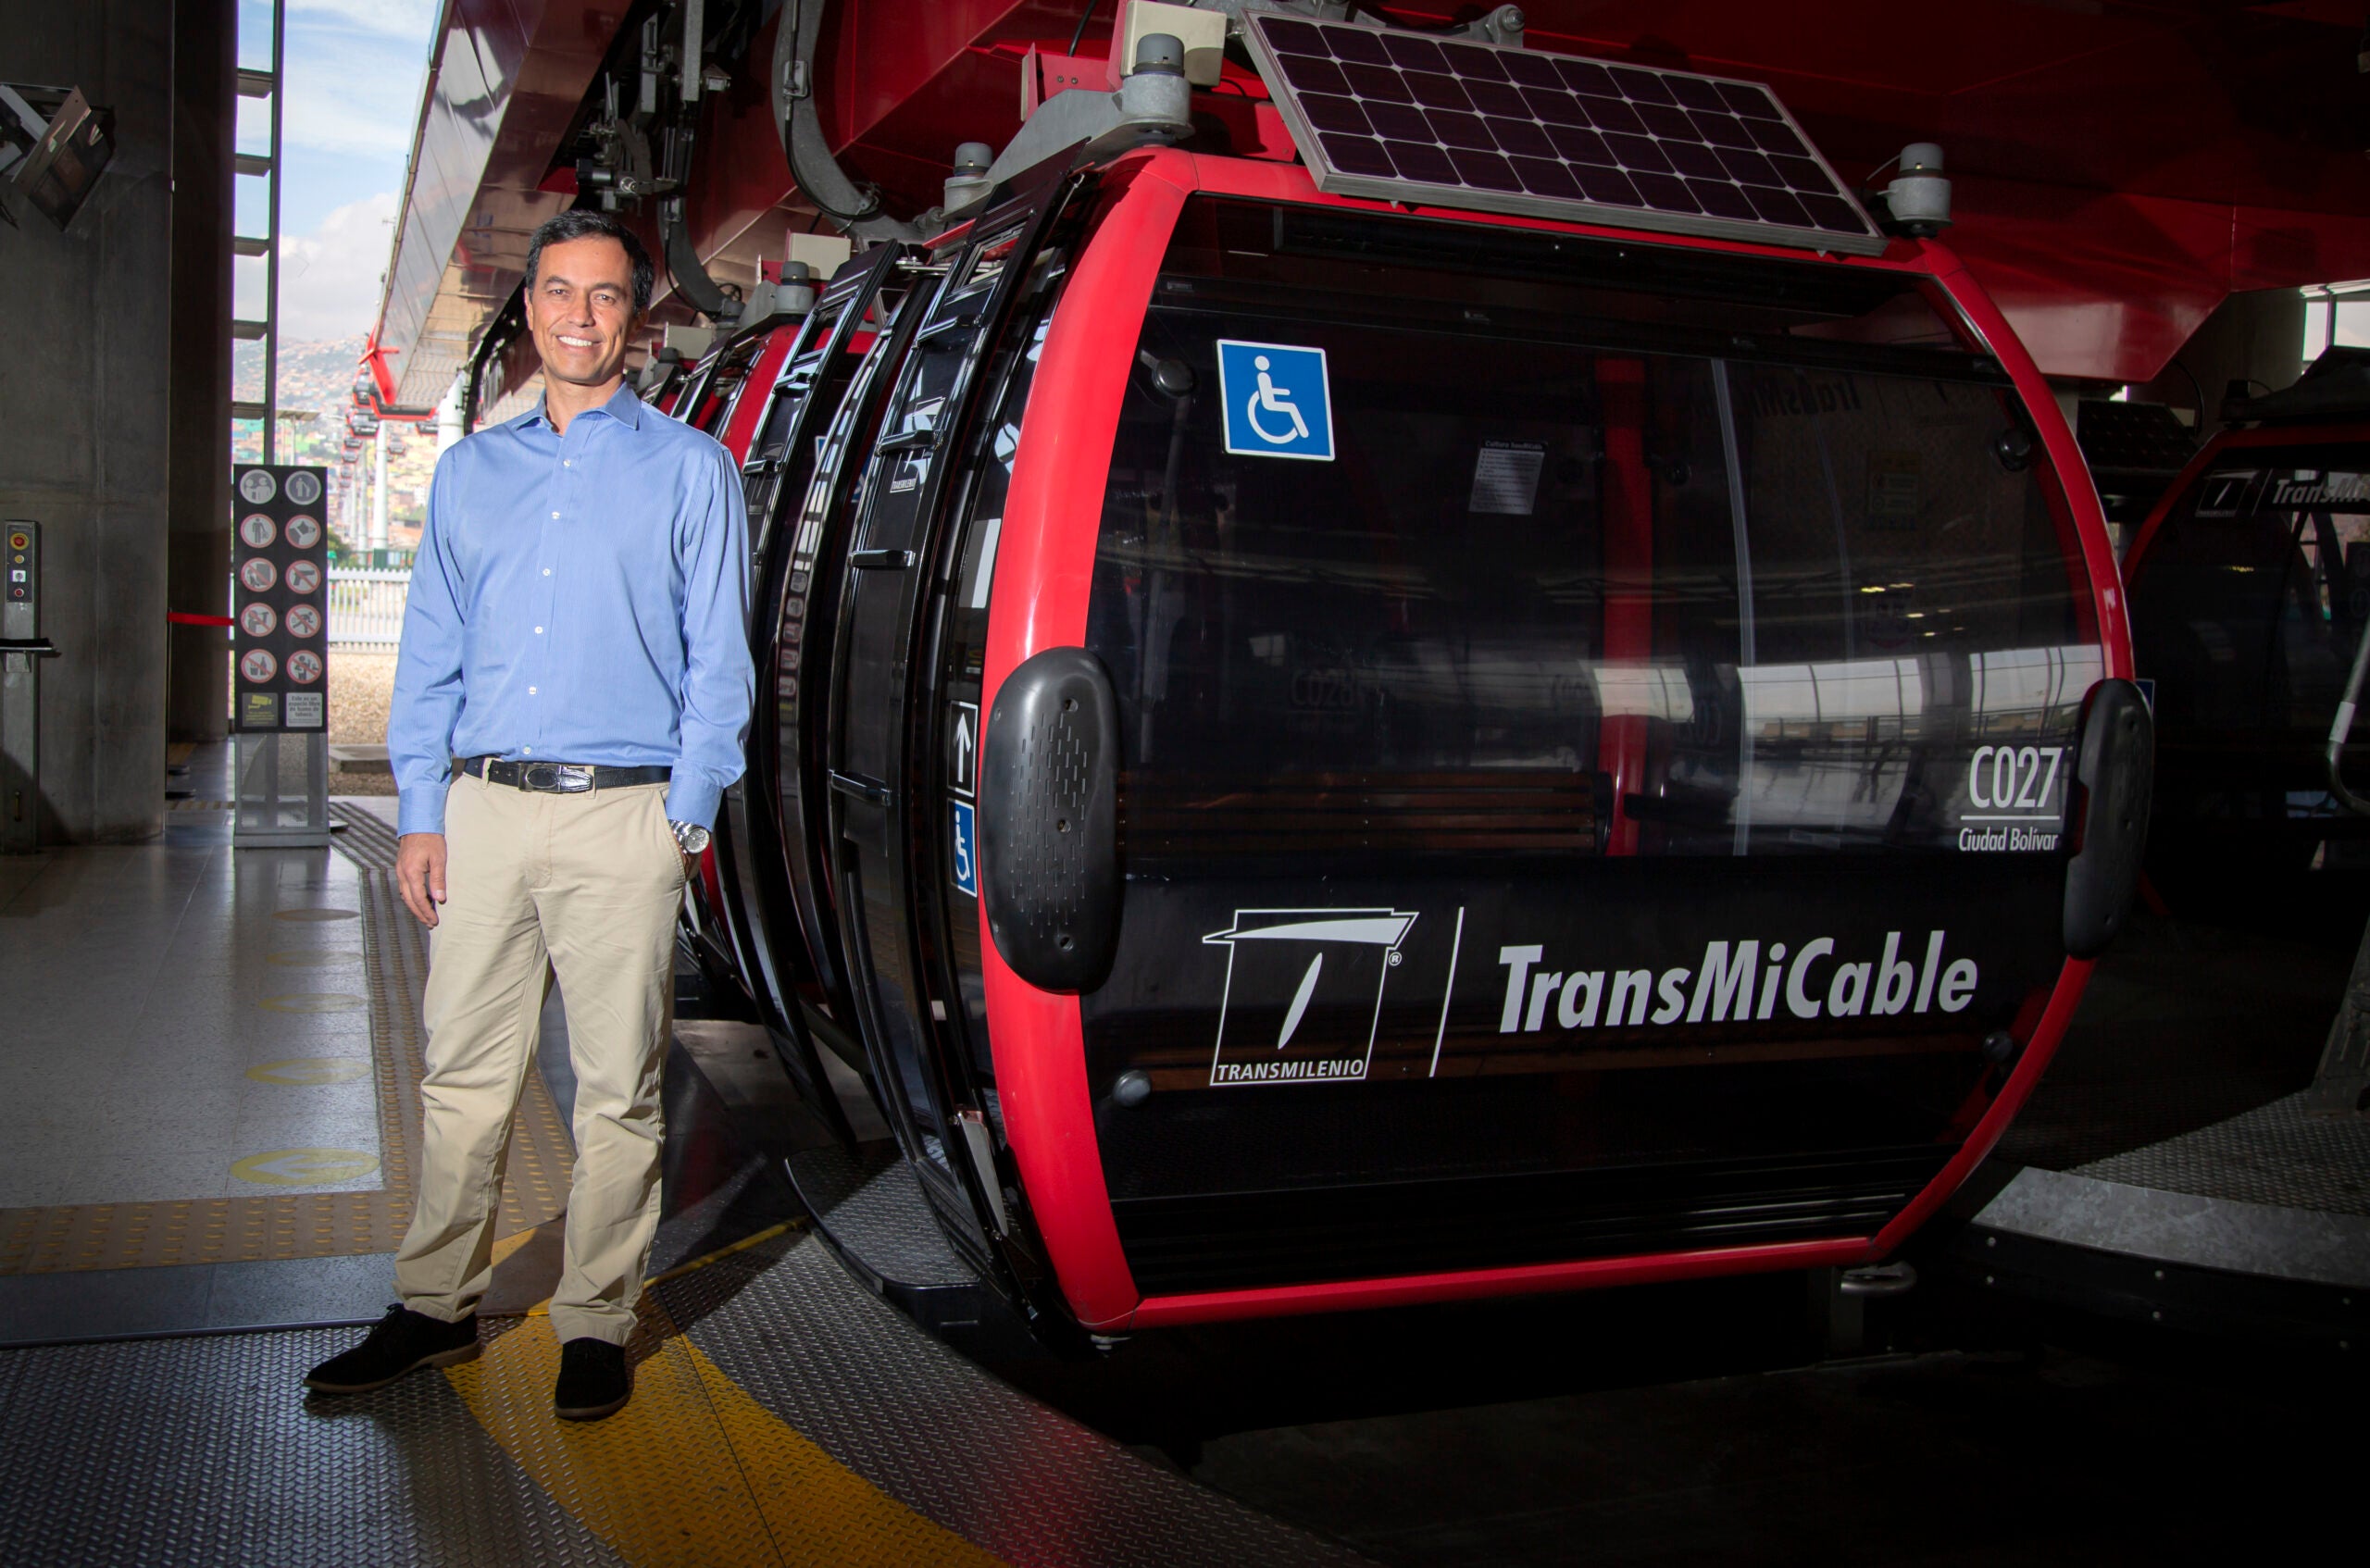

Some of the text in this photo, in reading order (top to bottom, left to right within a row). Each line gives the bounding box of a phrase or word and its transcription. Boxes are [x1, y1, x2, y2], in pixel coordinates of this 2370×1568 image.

[2273, 477, 2370, 504] TransMi
[1969, 745, 2063, 808] C027
[1959, 827, 2058, 852] Ciudad Bolívar
[1499, 930, 1977, 1033] TransMiCable
[1217, 1059, 1364, 1081] TRANSMILENIO
